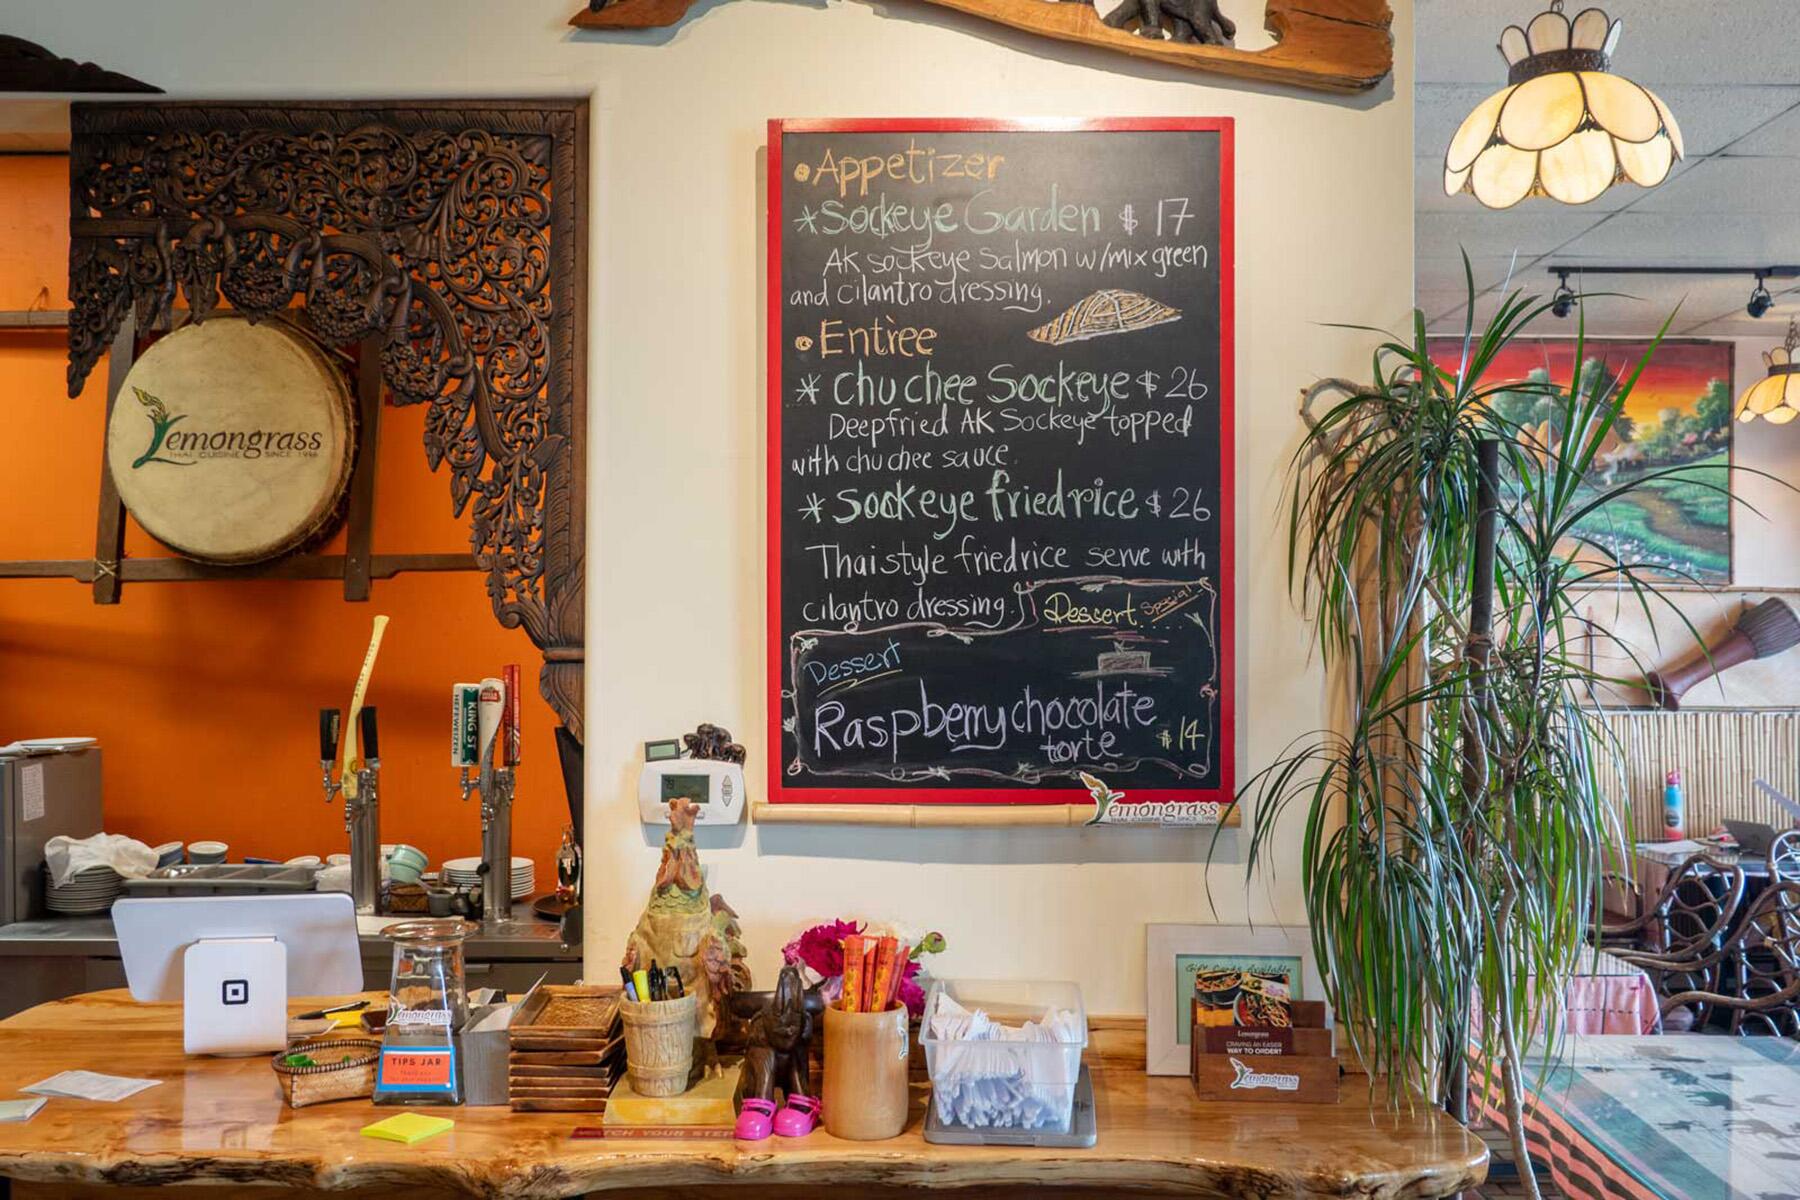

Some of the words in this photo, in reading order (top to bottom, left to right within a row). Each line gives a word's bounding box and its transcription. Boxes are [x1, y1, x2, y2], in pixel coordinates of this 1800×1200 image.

[811, 138, 1005, 198] Appetizer
[821, 192, 958, 250] Sockeye
[964, 183, 1101, 237] Garden
[822, 245, 861, 277] AK
[979, 239, 1068, 273] Salmon
[1152, 244, 1208, 278] green
[790, 278, 830, 306] and
[837, 274, 932, 306] cilantro
[986, 360, 1131, 418] Sockeye
[132, 404, 323, 469] Lemongrass
[960, 407, 996, 435] AK
[1000, 405, 1098, 446] Sockeye
[1103, 404, 1193, 444] topped
[791, 444, 839, 477] with
[832, 480, 979, 541] Sockeye
[1085, 546, 1152, 568] serve
[1161, 537, 1206, 570] with
[802, 590, 899, 623] cilantro
[803, 637, 901, 686] Dessert
[467, 701, 478, 732] KING
[814, 676, 1007, 764] Raspberry
[1011, 680, 1158, 736] chocolate
[1039, 729, 1124, 765] torte
[1086, 786, 1219, 826] Lemongrass
[392, 1057, 417, 1066] TIPS
[420, 1057, 442, 1066] JAR
[1243, 1047, 1254, 1055] TO
